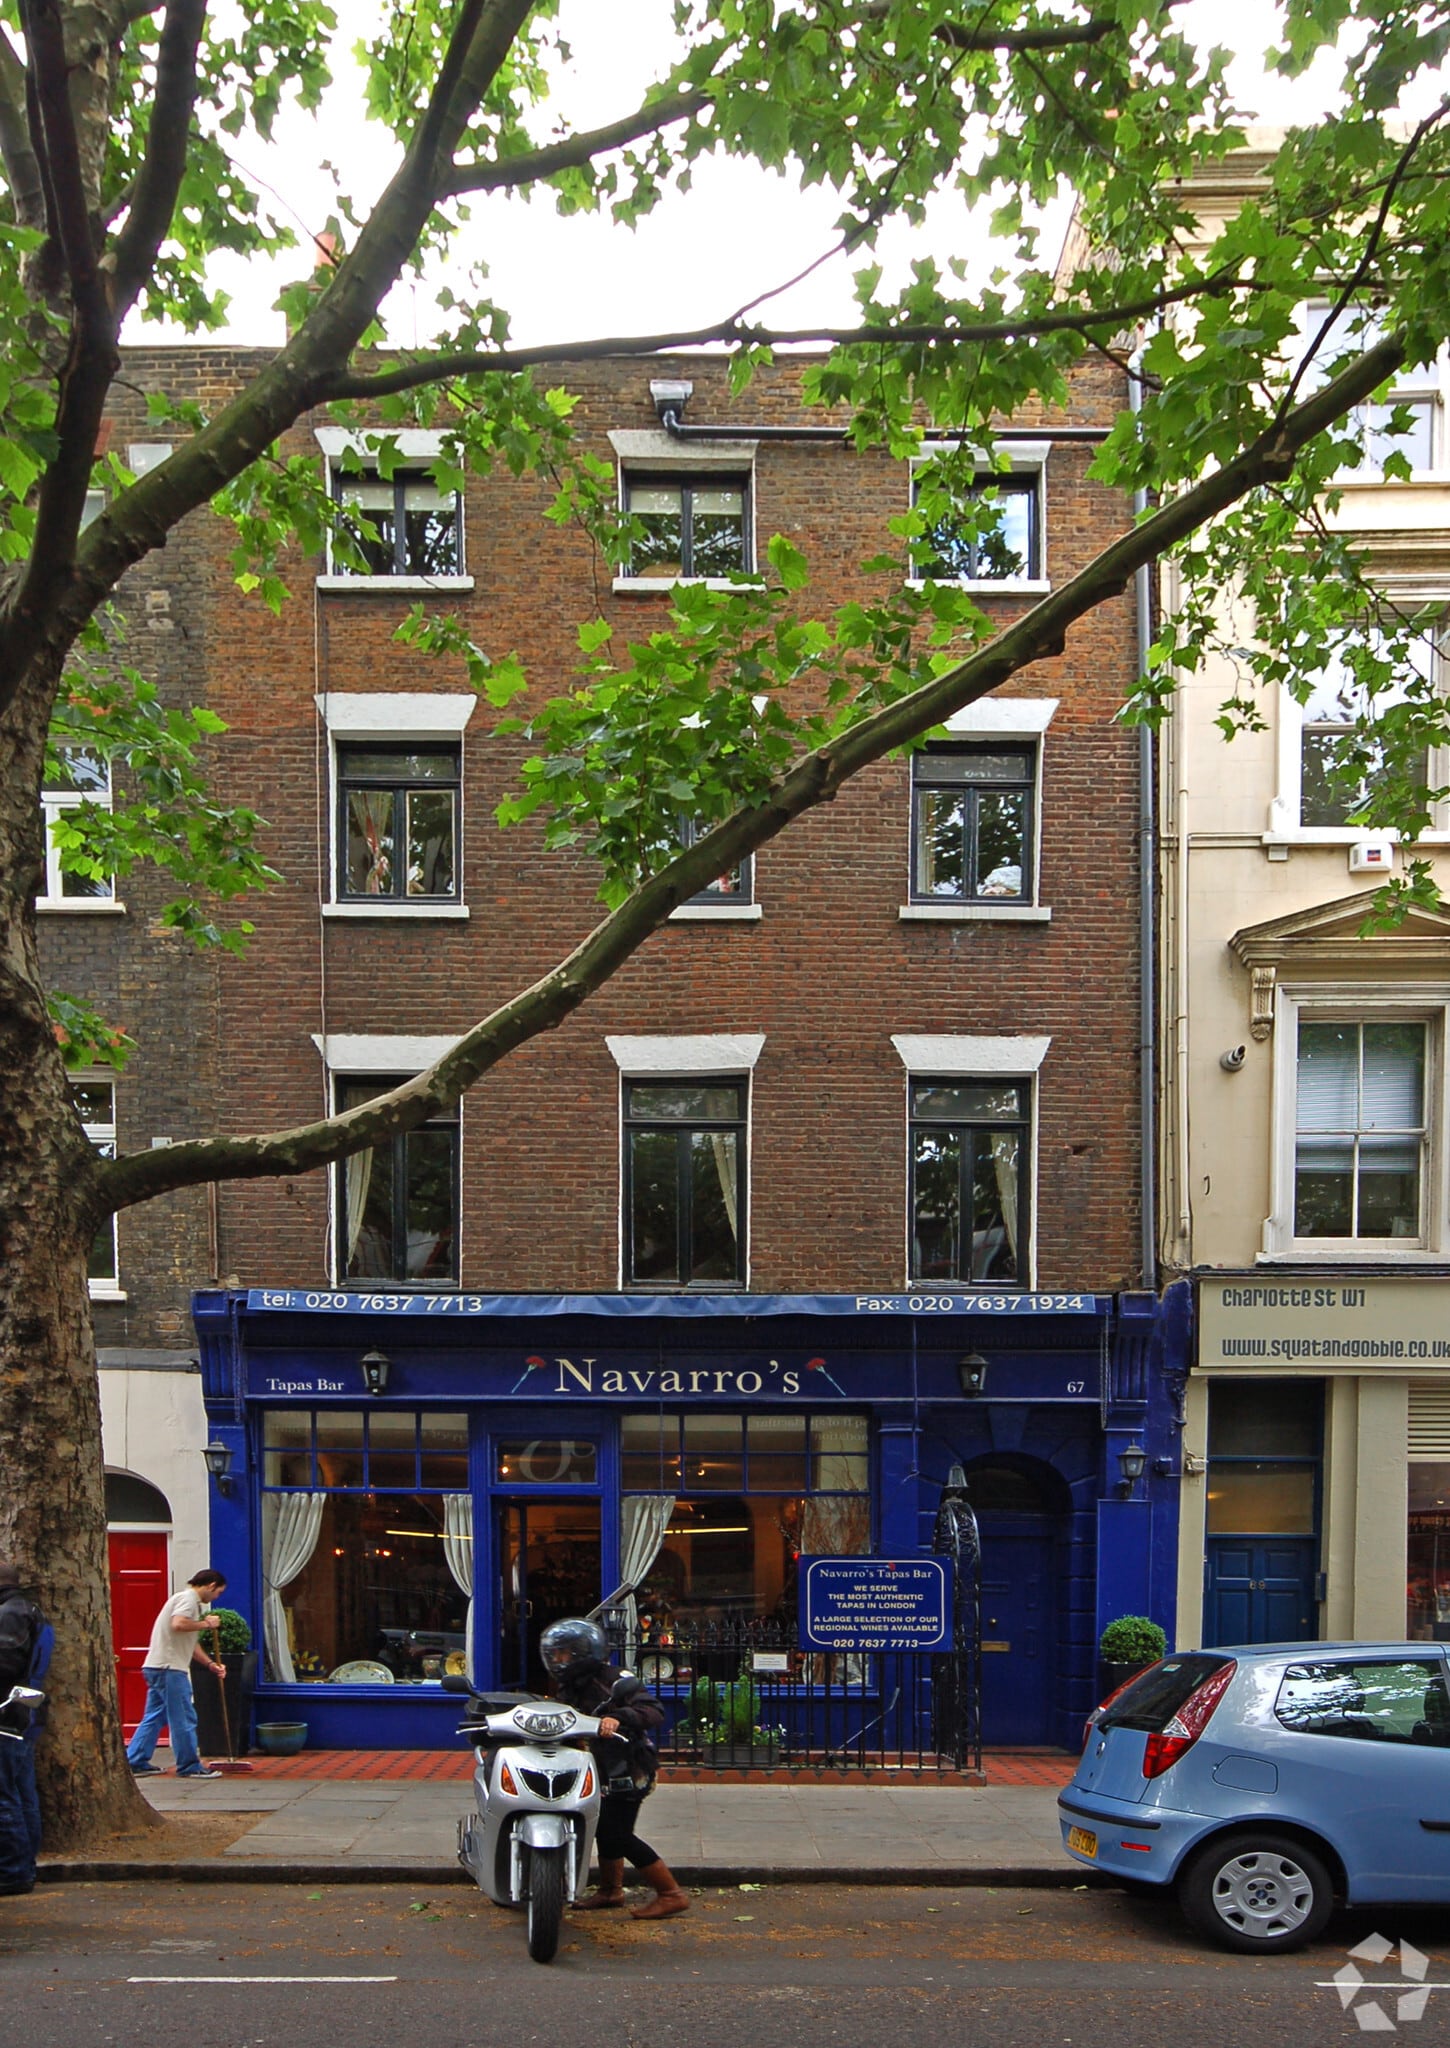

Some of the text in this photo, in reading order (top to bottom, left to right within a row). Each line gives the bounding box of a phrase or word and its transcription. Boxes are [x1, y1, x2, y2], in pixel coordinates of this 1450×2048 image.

[262, 1291, 482, 1312] tel: 020 7637 7713
[856, 1296, 1084, 1311] Fax: 020 7637 1924
[1222, 1288, 1366, 1307] Charlotte St W1
[1222, 1339, 1450, 1360] www.squatandgobble.co.uk
[554, 1358, 800, 1394] Navarro's
[266, 1378, 344, 1394] Tapas Bar
[1067, 1381, 1085, 1393] 67
[819, 1569, 933, 1580] Navarro's Tapas Bar
[833, 1639, 919, 1648] 020 7637 7713
